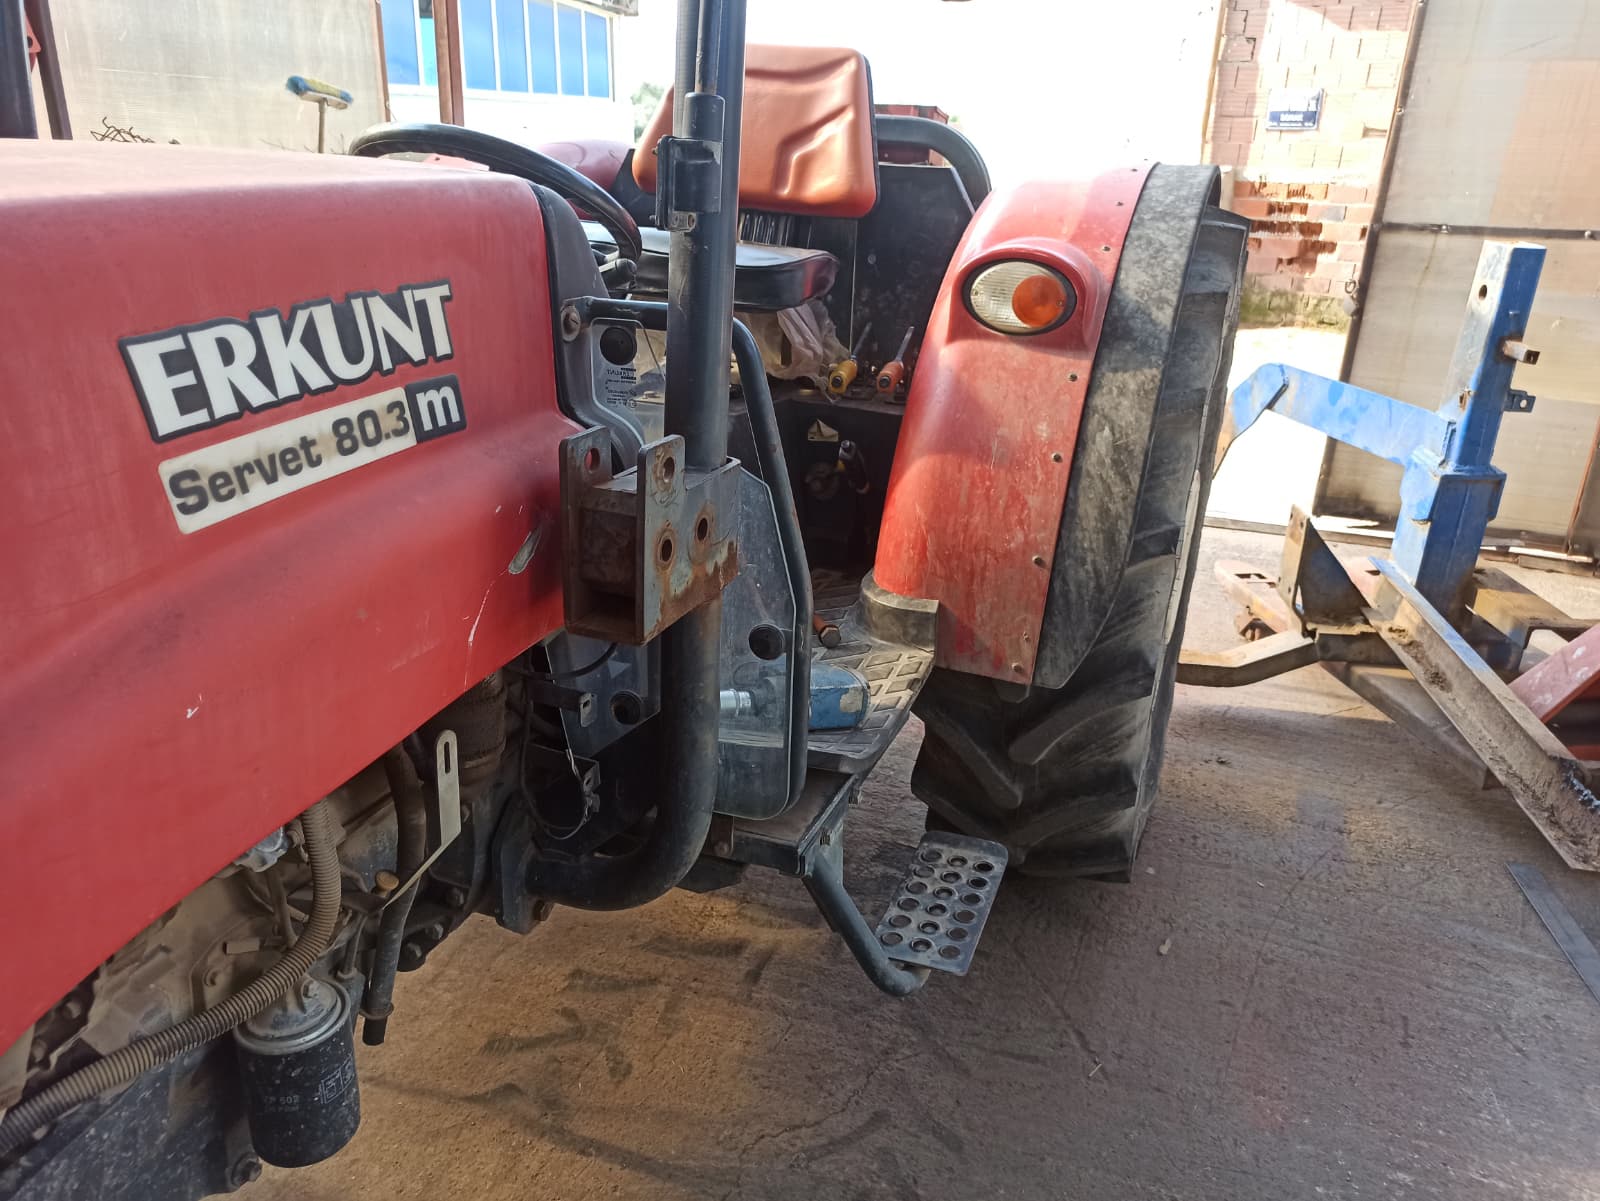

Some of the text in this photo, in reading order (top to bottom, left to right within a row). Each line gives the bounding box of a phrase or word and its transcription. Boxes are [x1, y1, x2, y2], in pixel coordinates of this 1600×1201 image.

[126, 282, 453, 438] ERKUNT
[168, 385, 461, 516] Servet 80.3 m
